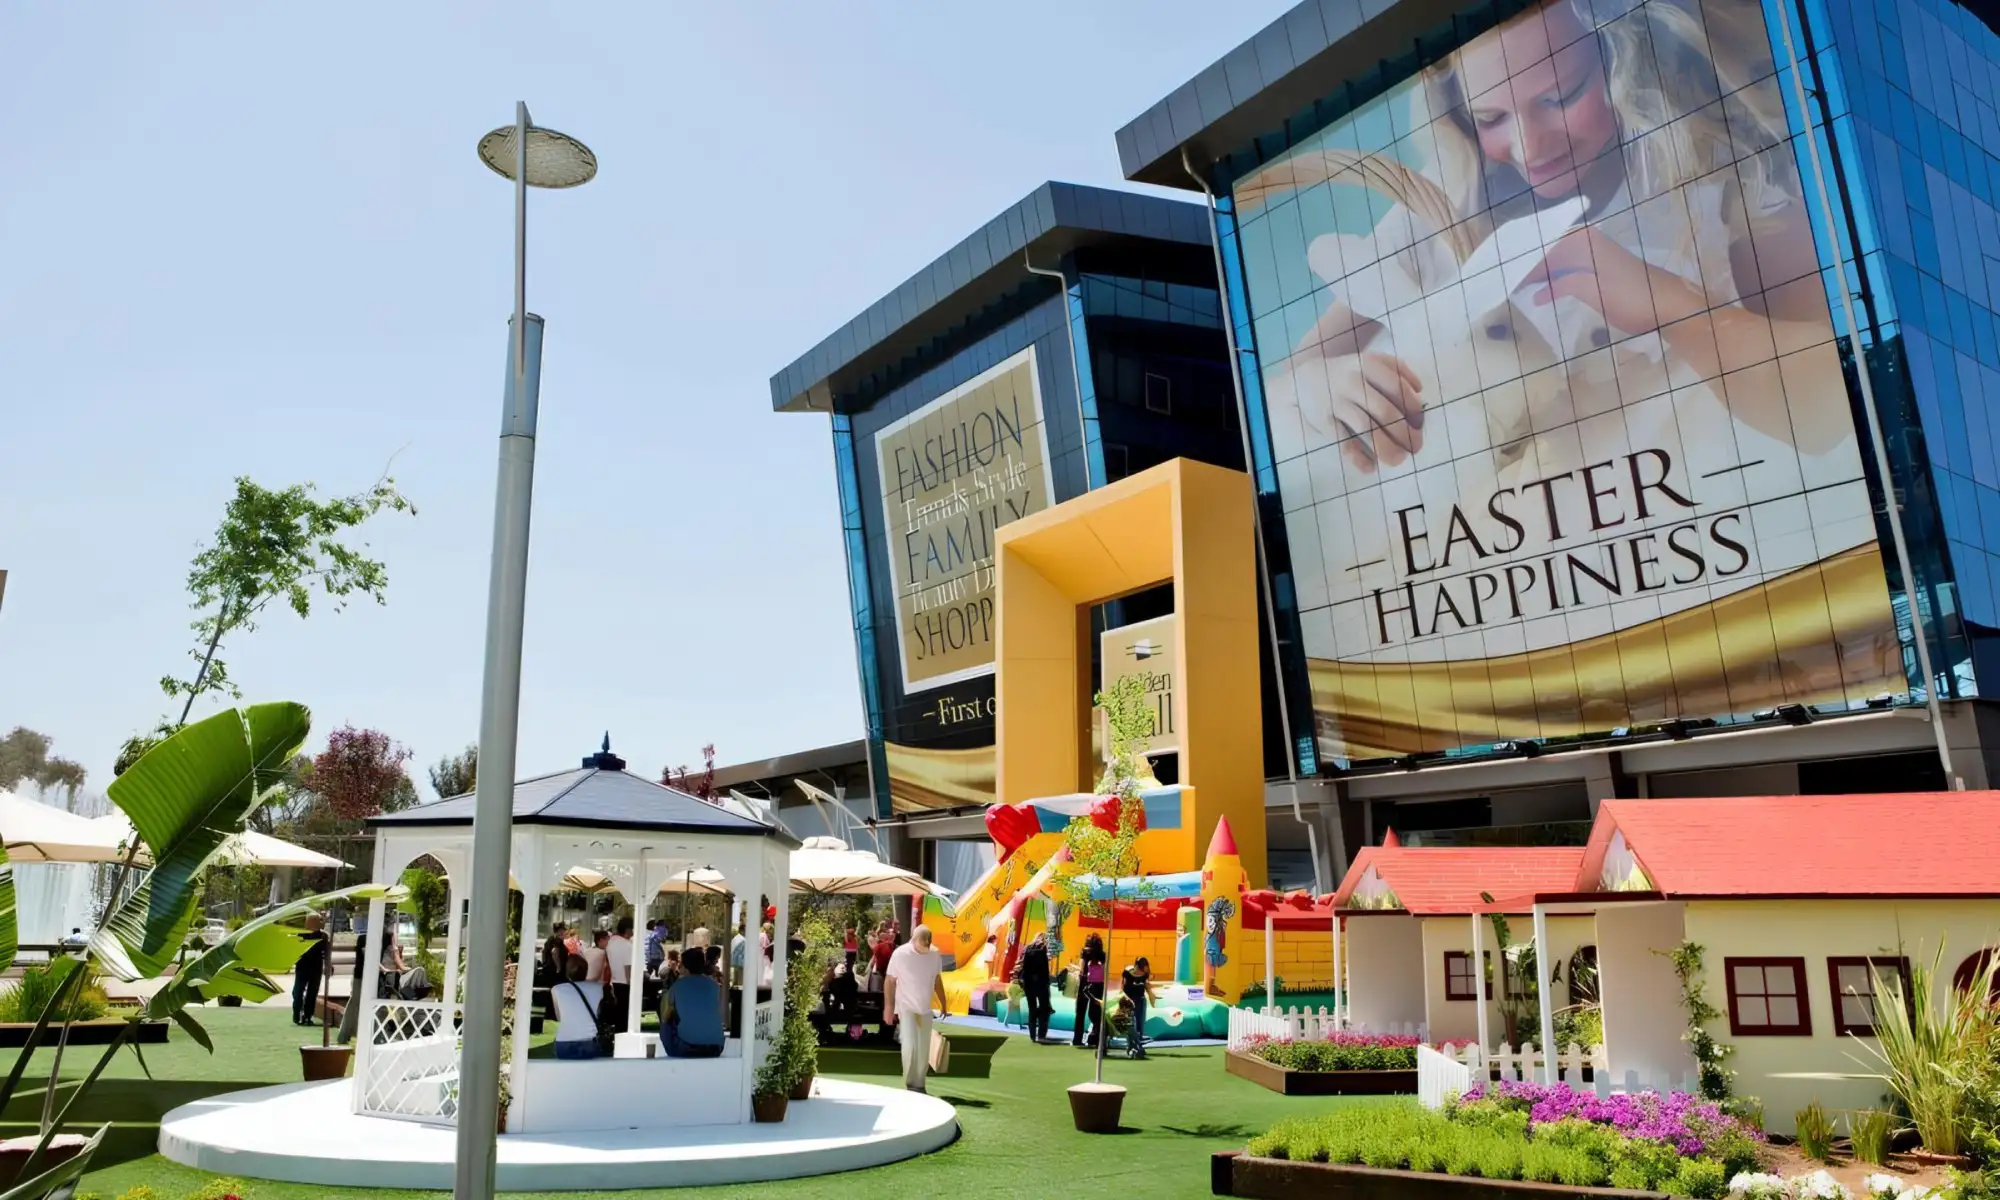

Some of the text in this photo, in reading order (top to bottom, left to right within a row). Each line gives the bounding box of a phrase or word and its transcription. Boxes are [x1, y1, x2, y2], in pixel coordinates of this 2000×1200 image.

[894, 395, 1023, 503] FASHION
[1393, 448, 1702, 576] EASTER
[913, 597, 993, 660] SHOPP
[1371, 514, 1750, 644] HAPPINESS
[938, 697, 982, 725] First
